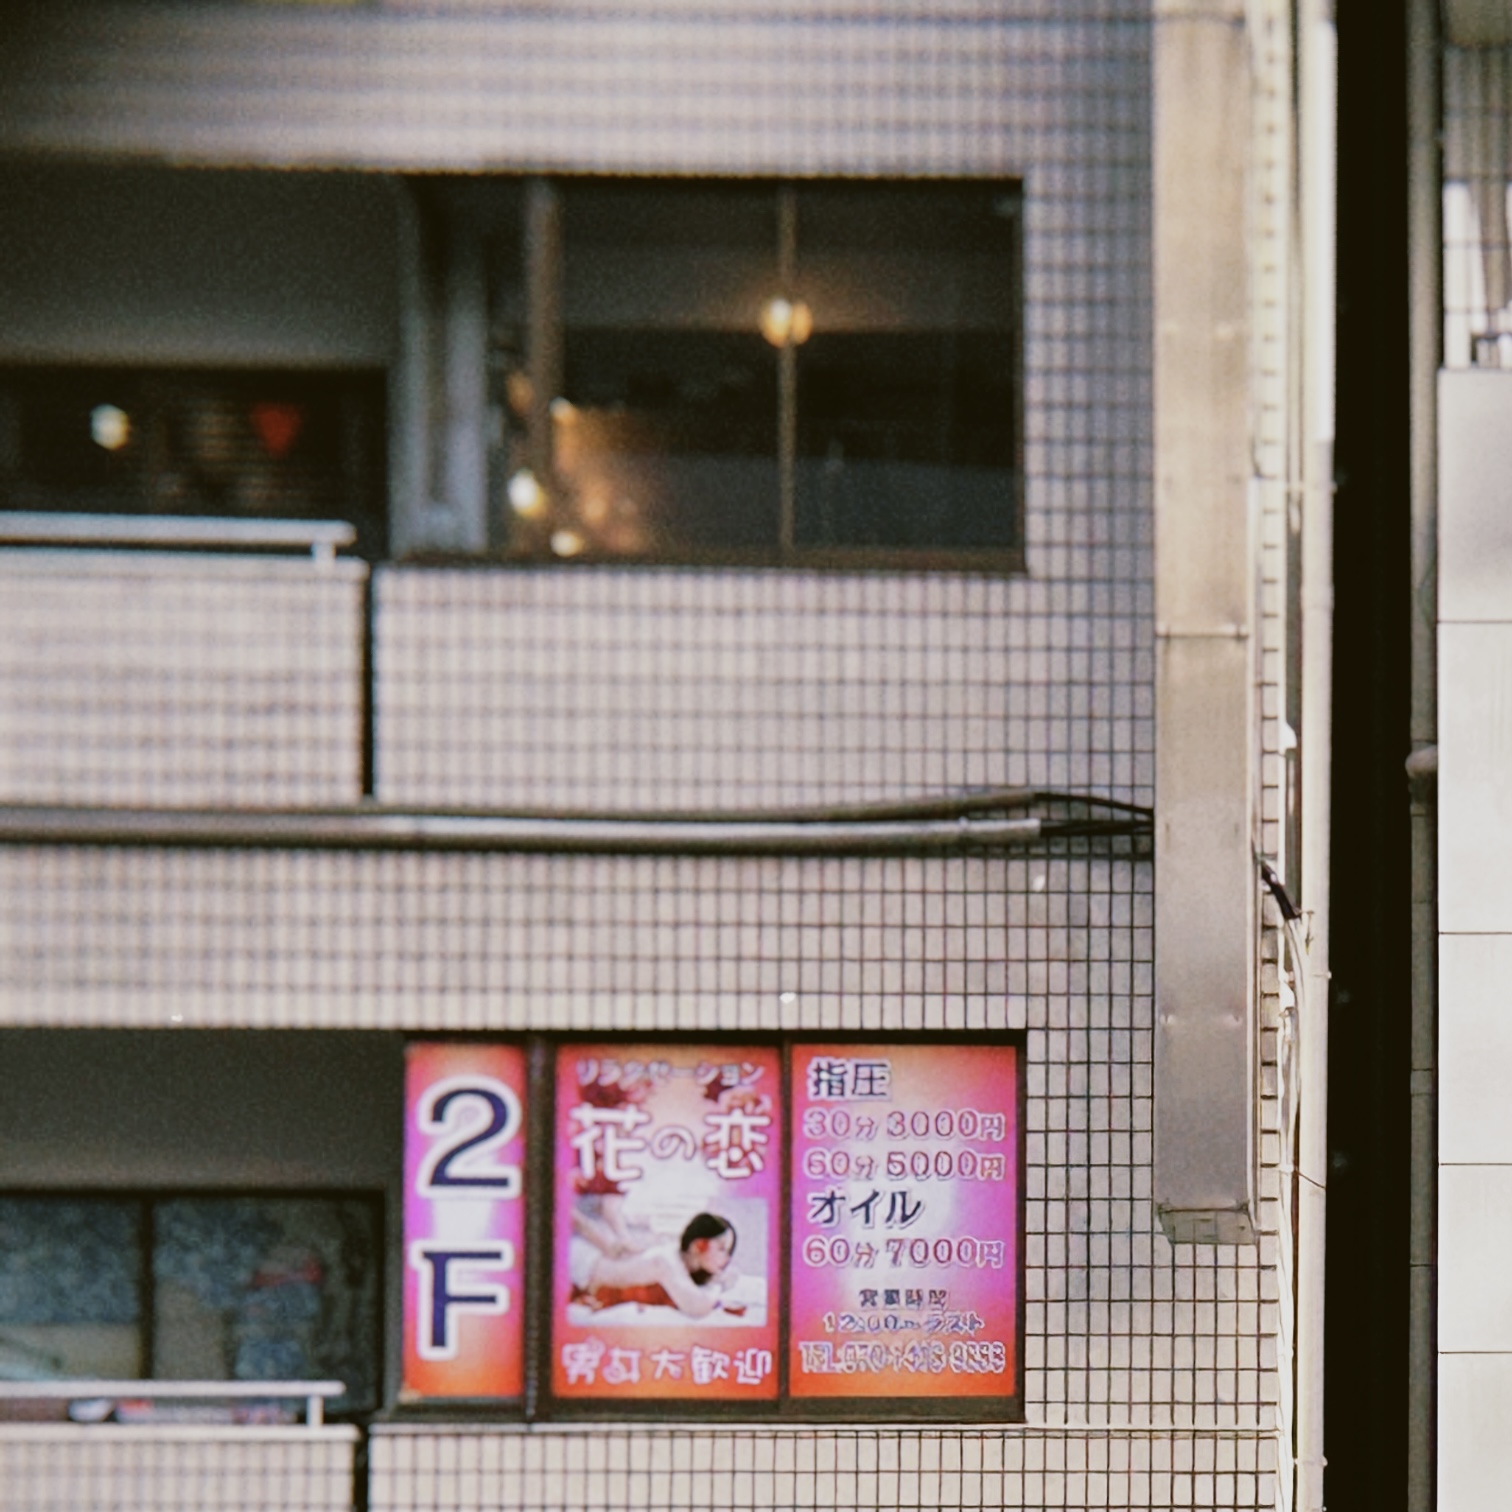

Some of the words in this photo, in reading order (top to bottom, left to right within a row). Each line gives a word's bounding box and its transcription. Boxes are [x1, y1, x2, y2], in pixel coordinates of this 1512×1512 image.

[812, 1060, 888, 1097] 指圧
[570, 1103, 771, 1181] 花の恋
[806, 1110, 878, 1138] 30分
[886, 1110, 1004, 1140] 3000円
[806, 1150, 877, 1179] 60分
[886, 1150, 1004, 1179] 5000円
[421, 1086, 510, 1349] 2F
[811, 1189, 922, 1226] オイル
[805, 1238, 877, 1267] 60分
[885, 1238, 1003, 1268] 7000円
